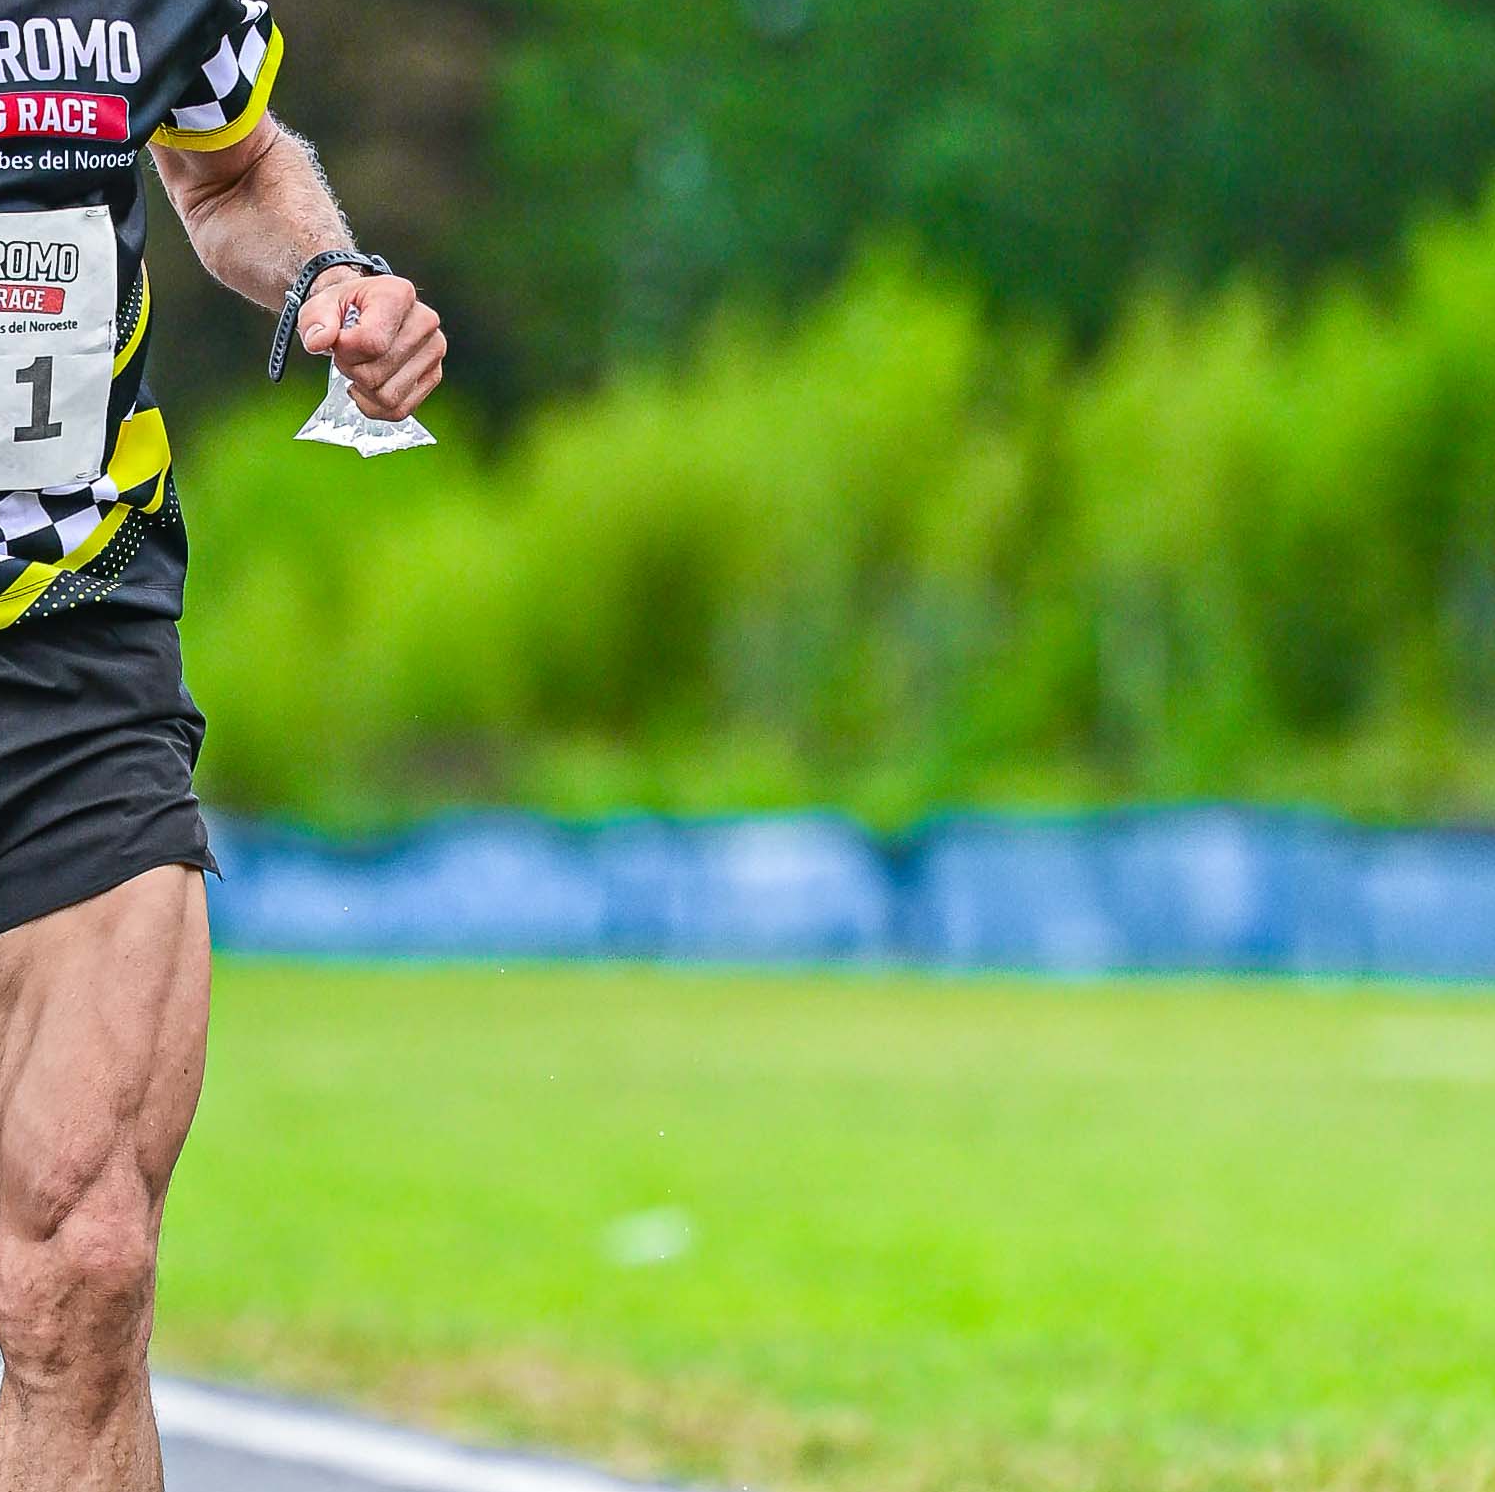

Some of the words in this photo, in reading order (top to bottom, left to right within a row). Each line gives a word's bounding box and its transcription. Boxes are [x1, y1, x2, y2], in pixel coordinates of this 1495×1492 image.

[17, 97, 98, 135] RACE
[38, 149, 69, 171] del
[8, 320, 27, 334] del
[29, 318, 78, 333] Noroeste
